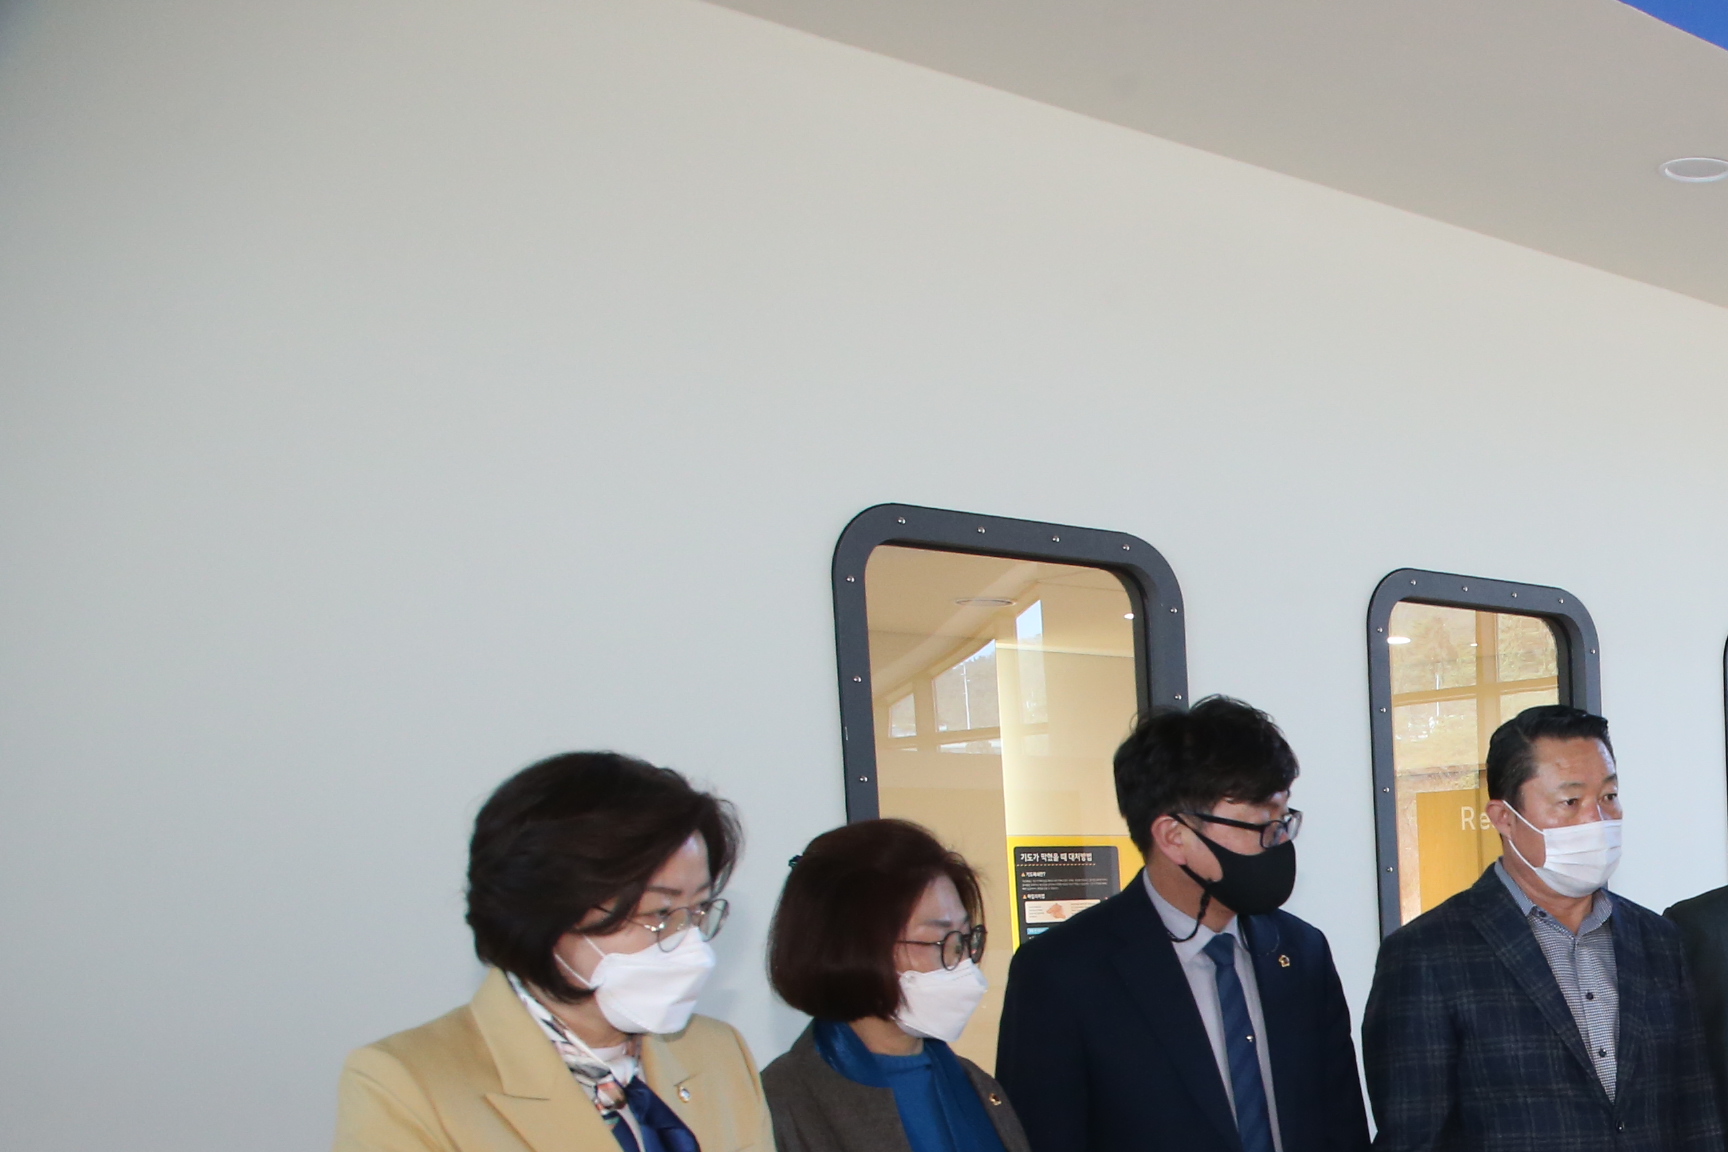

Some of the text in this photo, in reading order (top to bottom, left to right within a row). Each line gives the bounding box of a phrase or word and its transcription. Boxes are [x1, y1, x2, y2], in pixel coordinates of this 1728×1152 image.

[1461, 806, 1495, 830] Re
[1020, 852, 1039, 862] 기도가
[1060, 852, 1068, 862] 때
[1068, 852, 1092, 862] 대처방법
